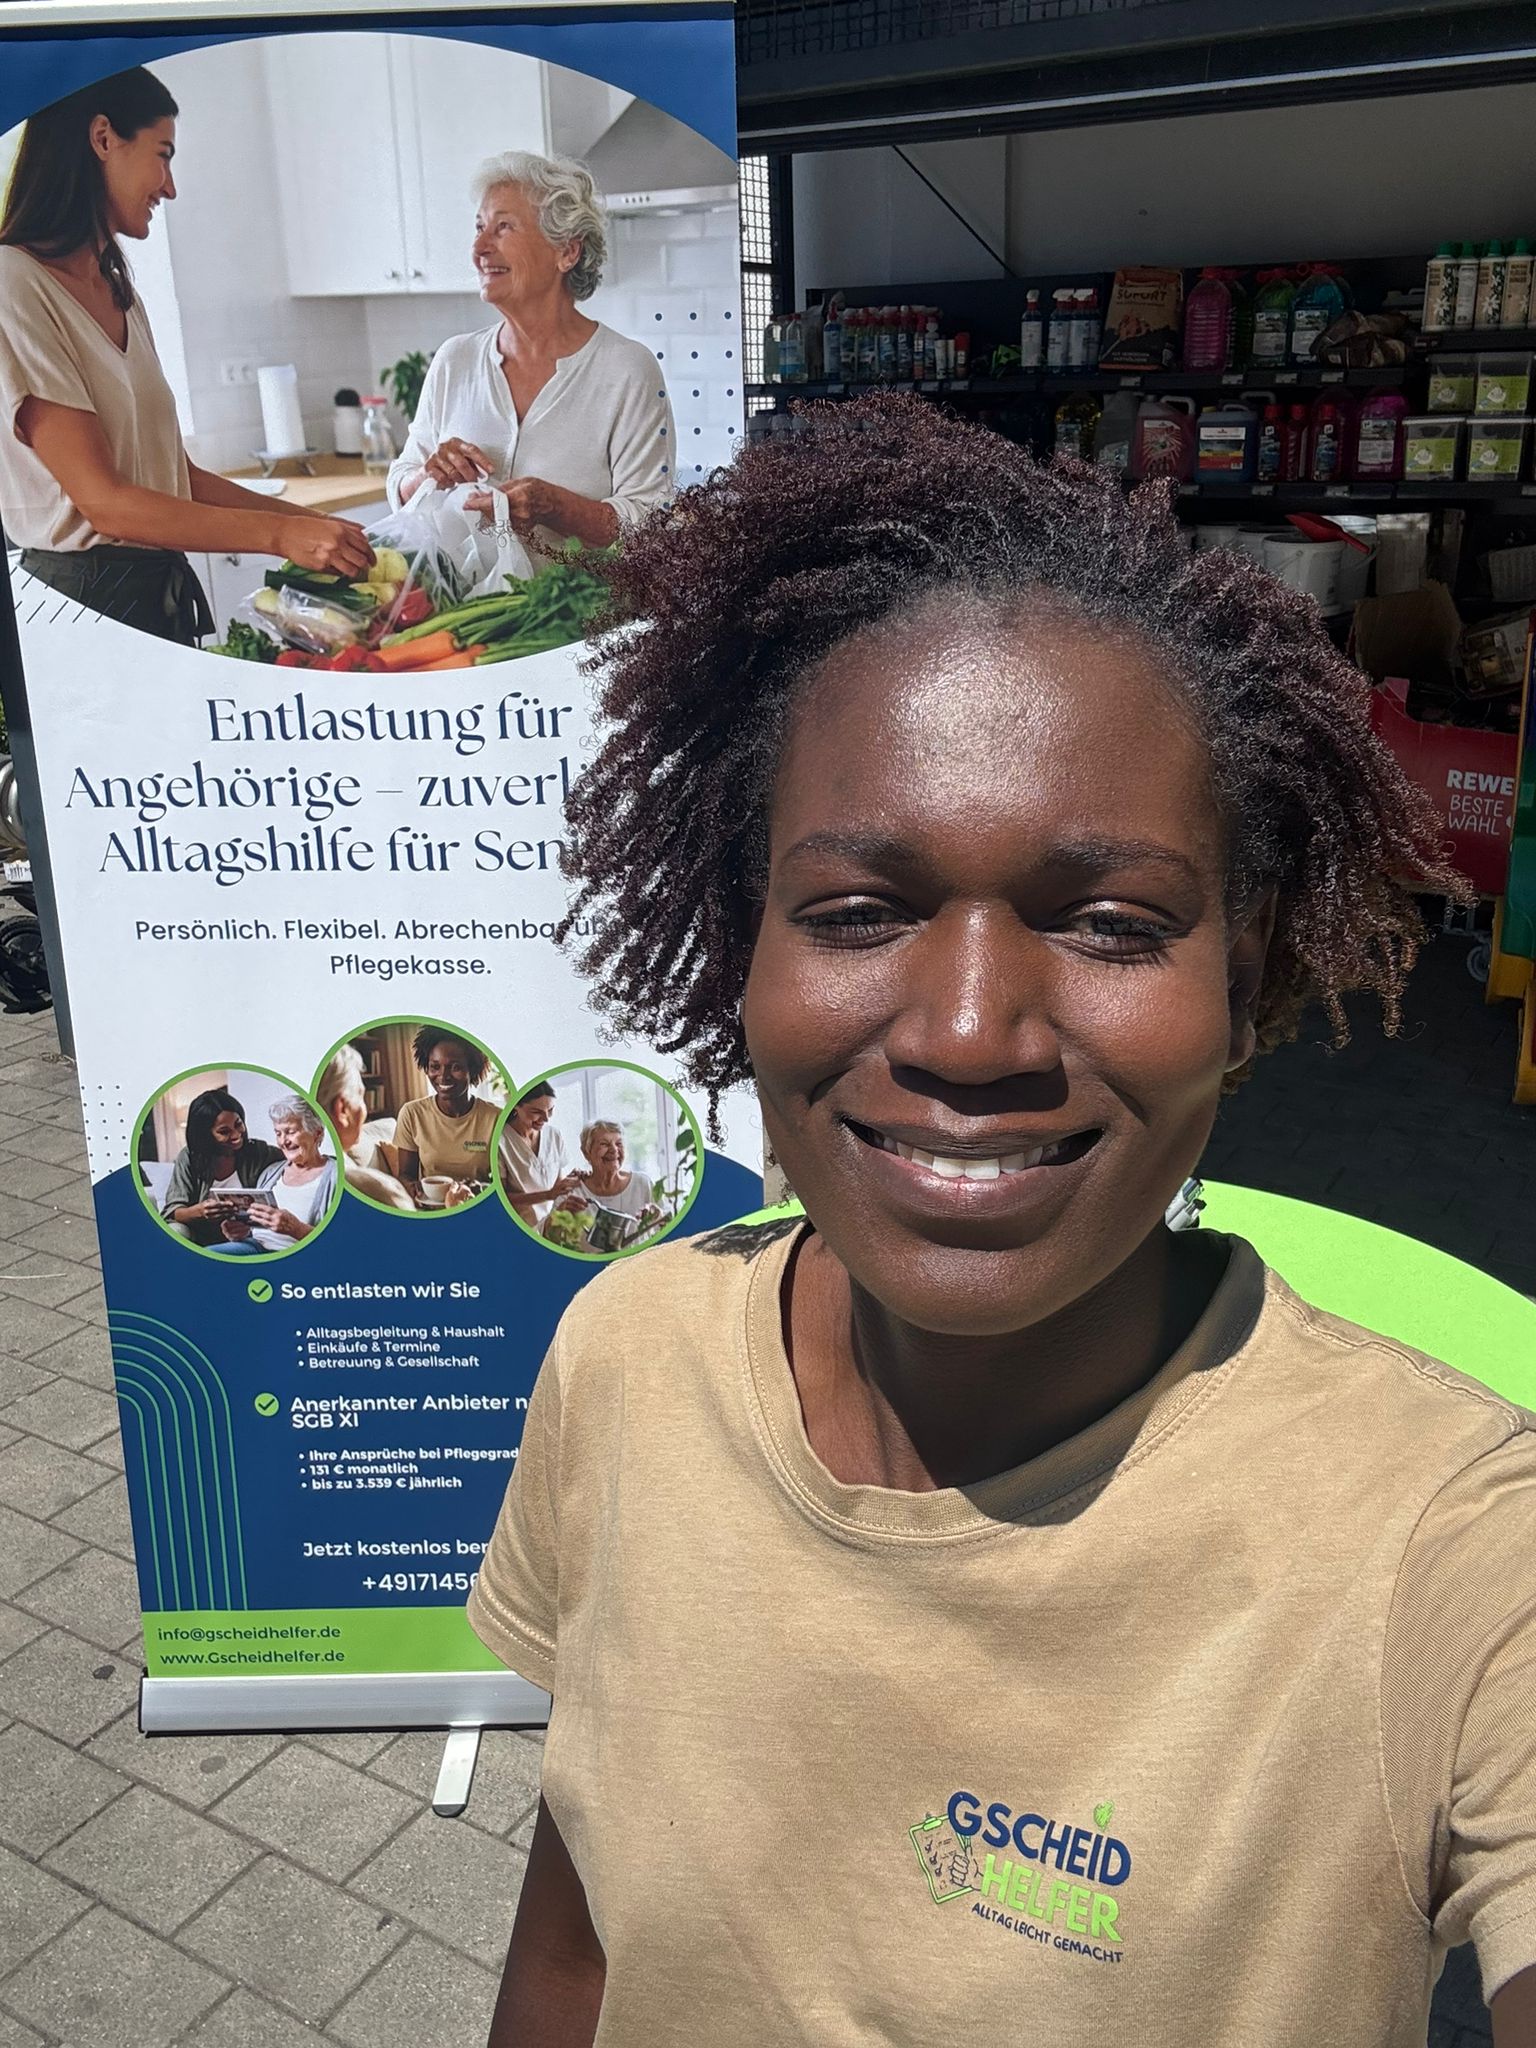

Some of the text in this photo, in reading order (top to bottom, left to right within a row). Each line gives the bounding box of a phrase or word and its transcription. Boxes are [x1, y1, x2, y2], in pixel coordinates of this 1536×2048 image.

[206, 691, 573, 755] Entlastung für
[64, 760, 363, 822] Angehörige
[418, 757, 588, 807] zuverl
[1446, 769, 1515, 796] REWE
[1450, 794, 1504, 817] BESTE
[1449, 812, 1500, 835] WAHL
[99, 825, 375, 886] Alltagshilfe
[387, 826, 460, 872] für
[135, 919, 277, 941] Persönlich.
[284, 919, 386, 940] Flexibel.
[394, 917, 556, 940] Abrechenba
[330, 954, 492, 981] Pflegekasse.
[281, 1282, 480, 1299] So entlasten wir Sie
[307, 1326, 505, 1340] Alltagsbegleitung & Haushalt
[308, 1341, 440, 1353] Einkäufe & Termine
[309, 1356, 479, 1369] Betreuung & Gesellschaft
[291, 1395, 418, 1412] Anerkannter
[423, 1394, 509, 1410] Anbieter
[292, 1412, 359, 1428] SGB XI
[309, 1447, 519, 1462] Ihre Ansprüche bei Pflegegrad
[310, 1462, 418, 1475] 131 € monatlich
[312, 1476, 462, 1490] bis zu 3.539 € jährlich
[303, 1541, 352, 1557] Jetzt
[358, 1540, 451, 1556] kostenlos
[158, 1626, 341, 1642] info@gscheidhelfer.de
[160, 1650, 345, 1664] www.Gscheidhelfer.de
[947, 1791, 1131, 1886] GSCHEID
[981, 1853, 1123, 1943] HELFER
[972, 1902, 1123, 1963] ALLTAG LEICHT GEMACHT
